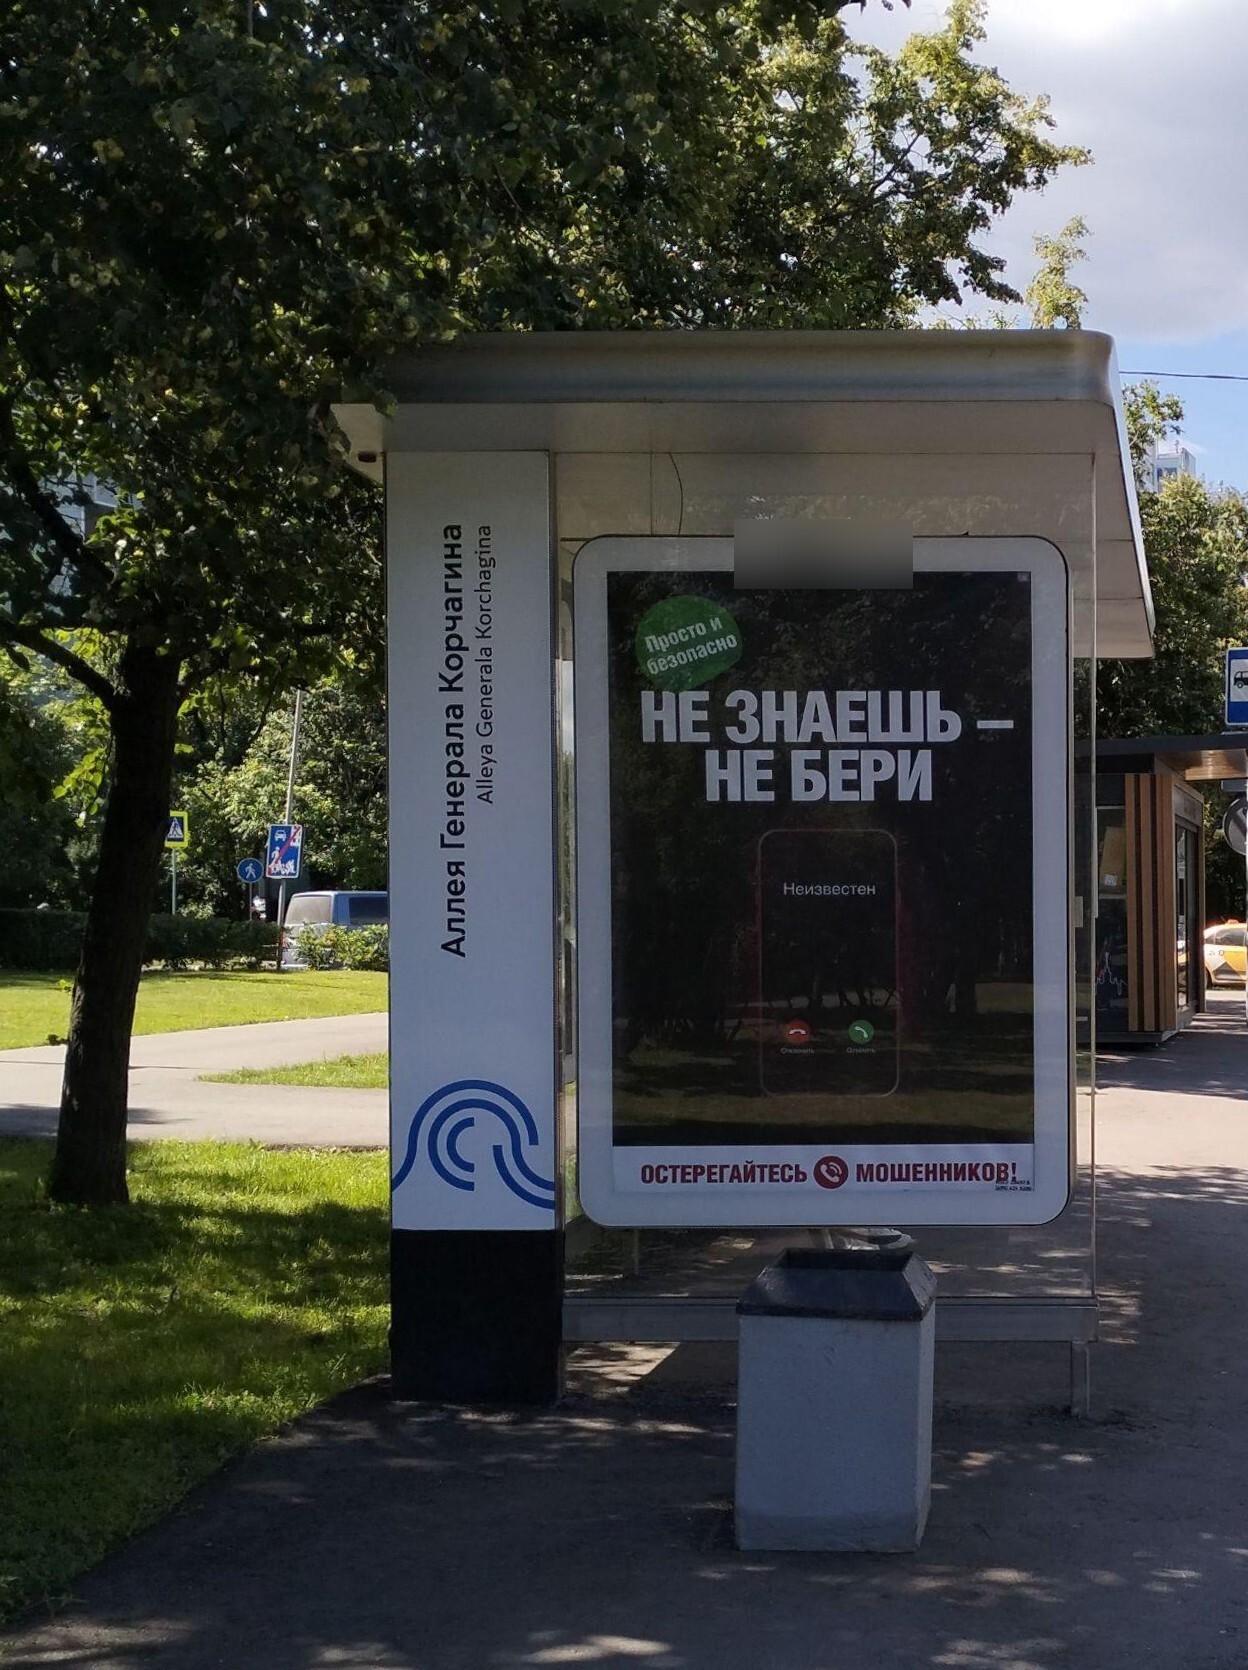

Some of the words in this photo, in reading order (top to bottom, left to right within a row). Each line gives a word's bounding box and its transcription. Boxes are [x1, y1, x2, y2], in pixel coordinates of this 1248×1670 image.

[438, 524, 470, 693] Корчагина
[474, 525, 496, 639] Korchagina
[644, 622, 707, 653] Просто
[709, 616, 724, 632] и
[646, 634, 738, 675] безопасно
[474, 647, 494, 738] Generala
[640, 690, 711, 743] НЕ
[724, 689, 963, 744] ЗНАЕШЬ
[439, 704, 471, 849] Генерала
[475, 744, 498, 805] Alleya
[705, 749, 775, 802] НЕ
[790, 749, 933, 802] БЕРИ
[440, 861, 467, 958] Аллея
[783, 882, 876, 896] Неизвестен
[641, 1160, 808, 1184] ОСТЕРЕГАЙТЕСЬ
[856, 1162, 1017, 1182] МОШЕННИКОВ!
